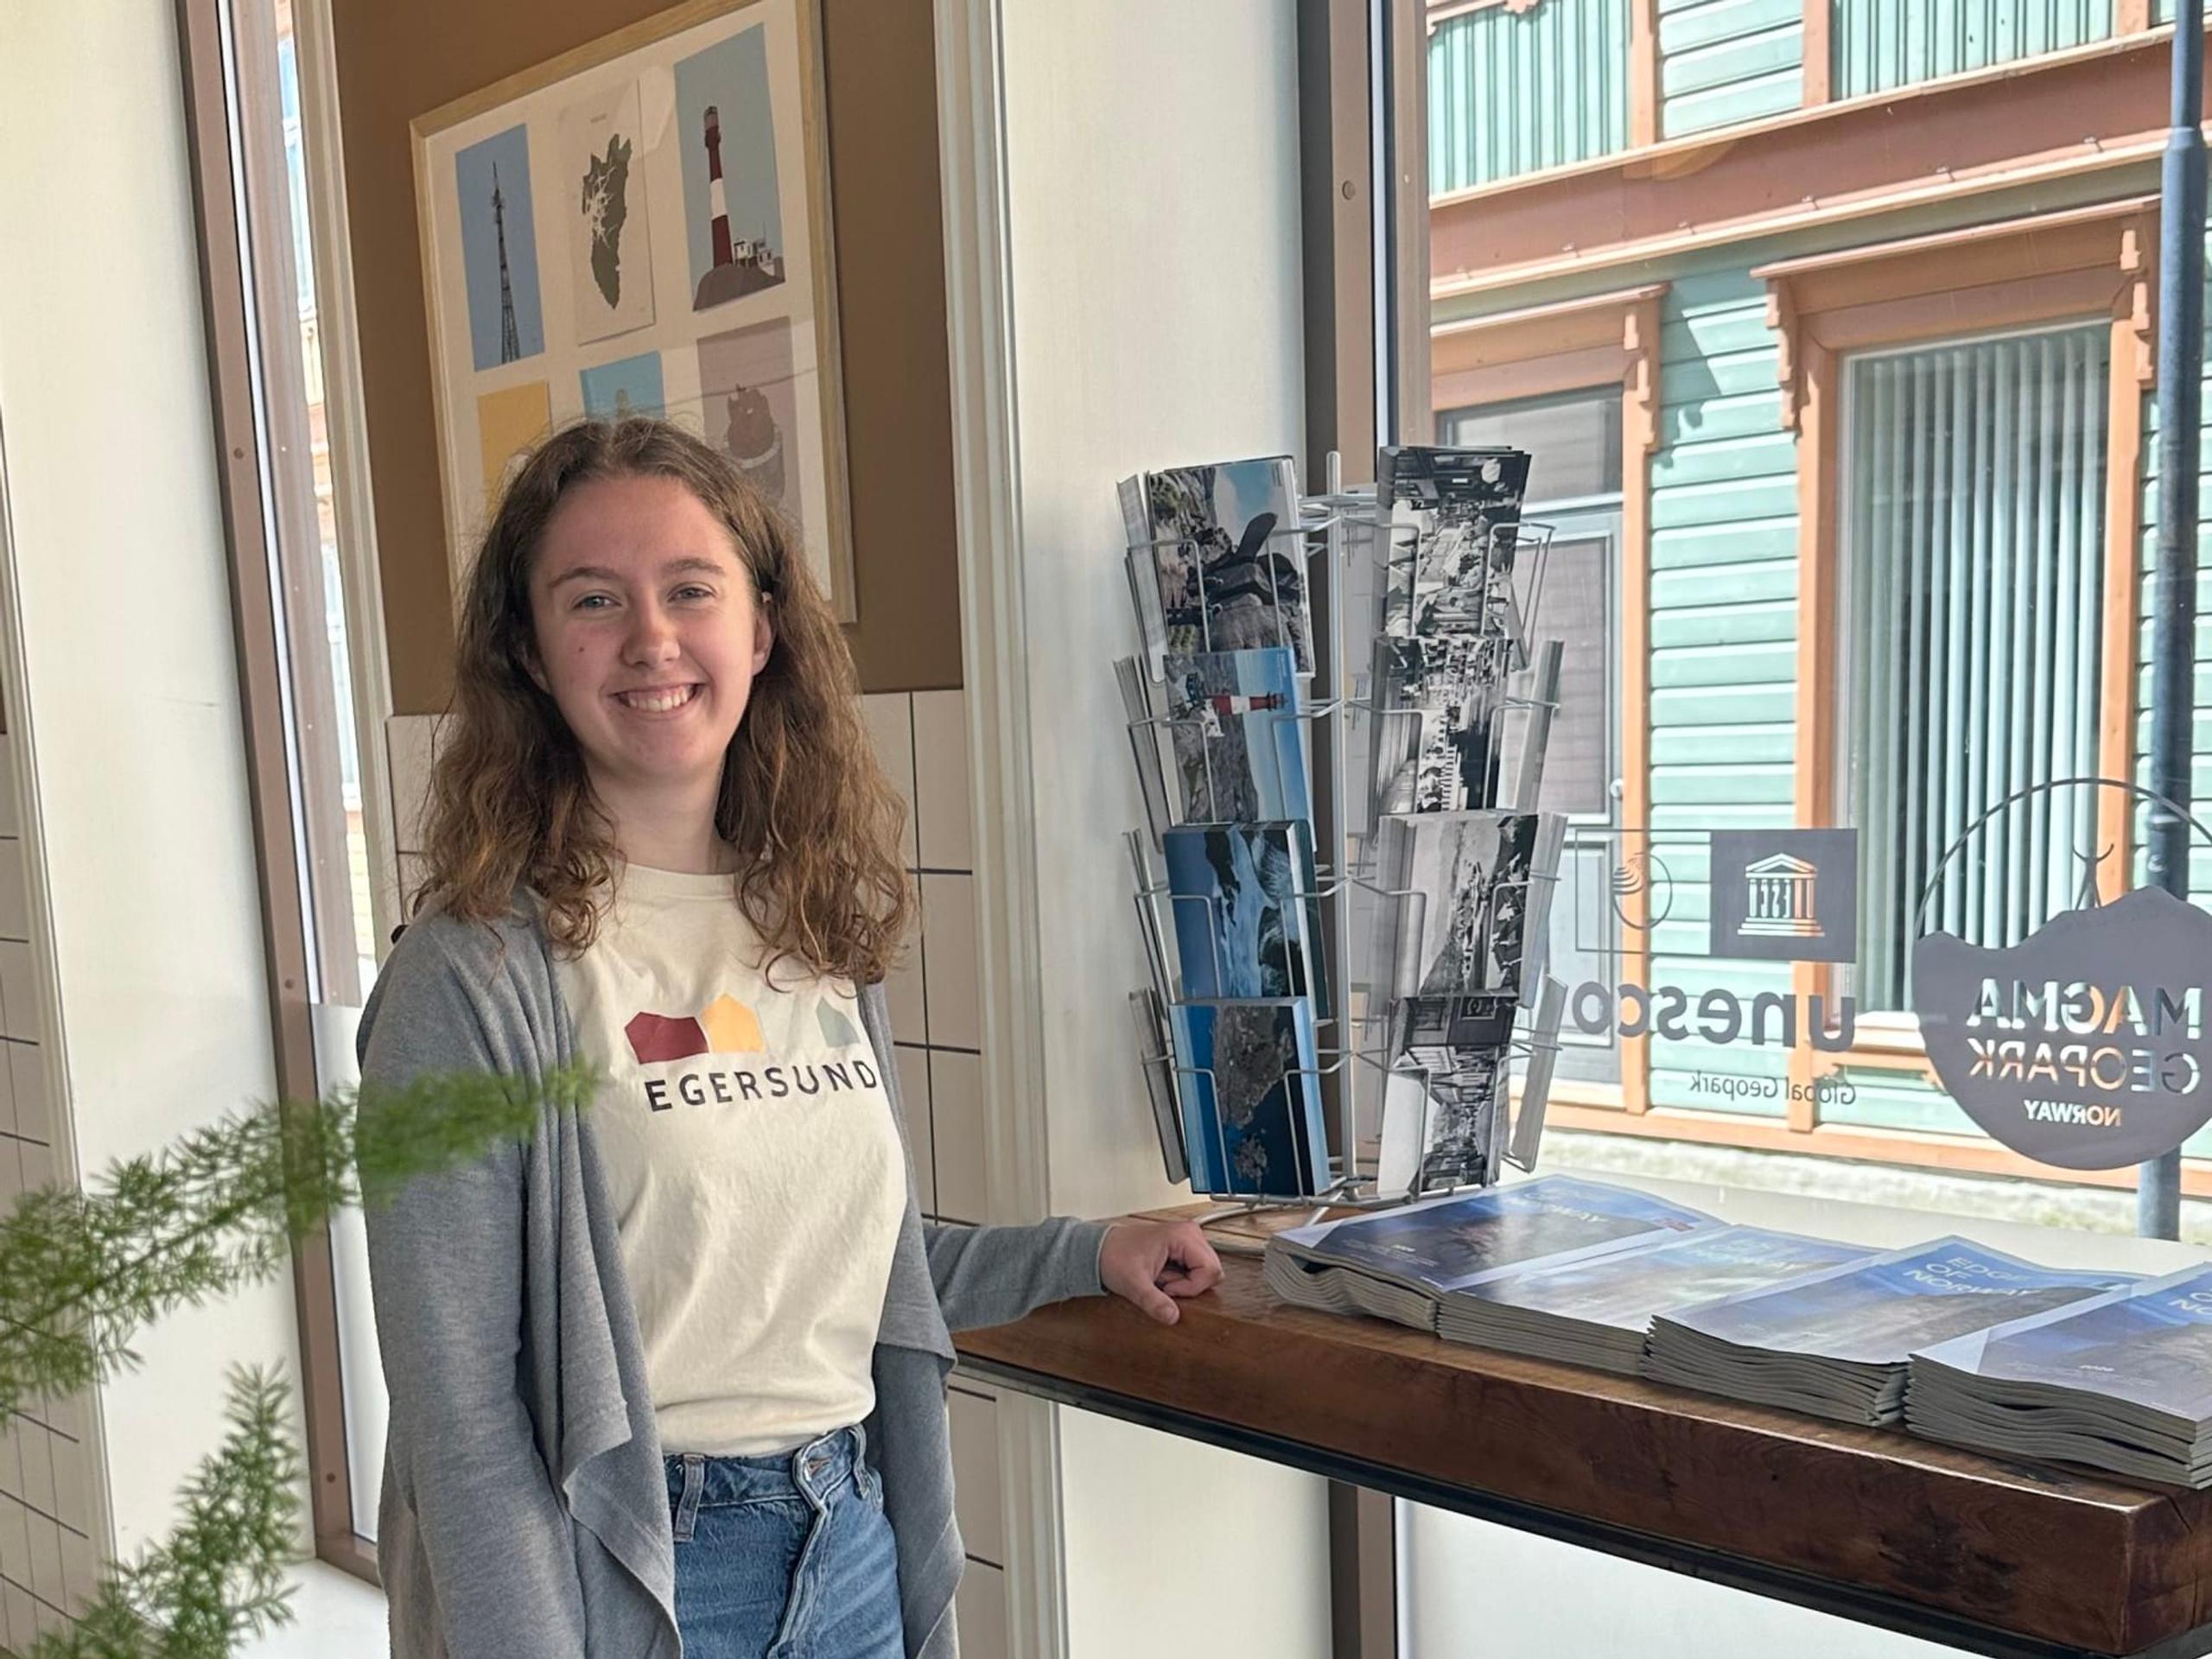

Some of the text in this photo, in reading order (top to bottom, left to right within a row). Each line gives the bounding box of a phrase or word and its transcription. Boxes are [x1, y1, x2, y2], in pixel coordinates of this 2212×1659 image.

[645, 1059, 878, 1112] EGERSUND
[1902, 1269, 2042, 1295] NORWAY
[1926, 1262, 1973, 1280] OF
